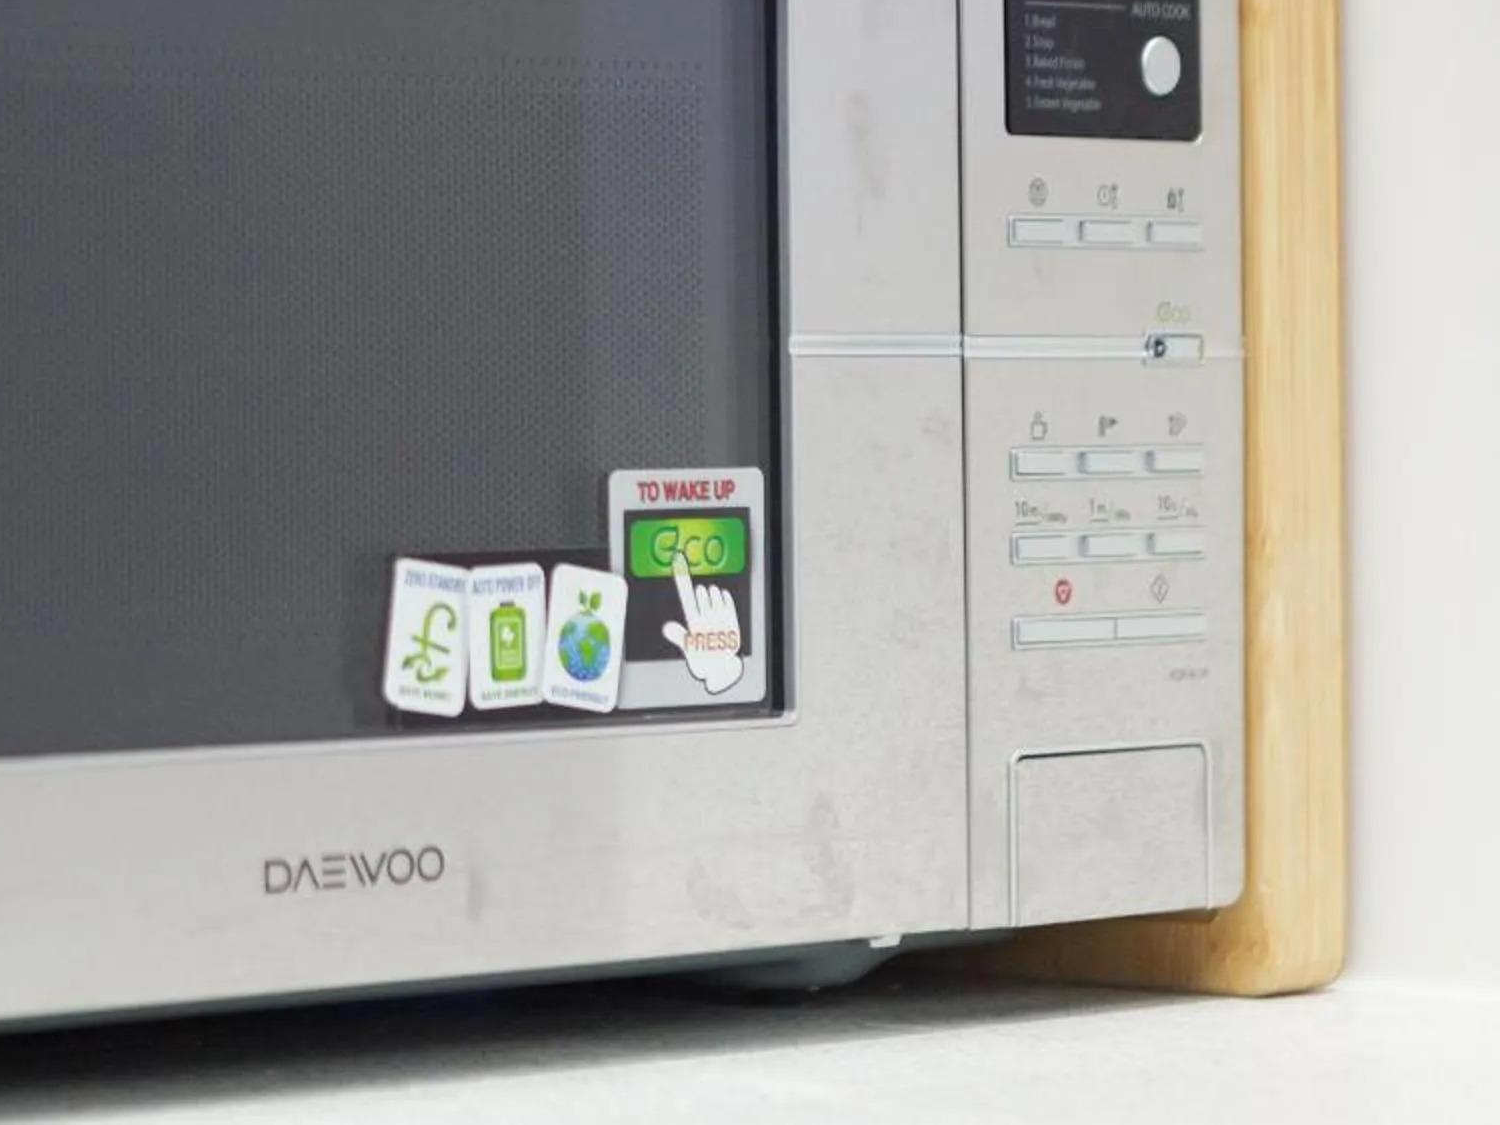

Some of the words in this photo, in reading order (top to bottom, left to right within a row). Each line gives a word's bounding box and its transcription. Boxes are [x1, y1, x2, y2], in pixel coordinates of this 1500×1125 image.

[1131, 1, 1160, 19] AUTO
[1162, 2, 1191, 20] COOK
[637, 481, 659, 502] TO
[664, 480, 711, 501] WAKE
[713, 480, 736, 501] UP
[684, 631, 740, 653] PRESS
[263, 845, 445, 895] DAEWOO
